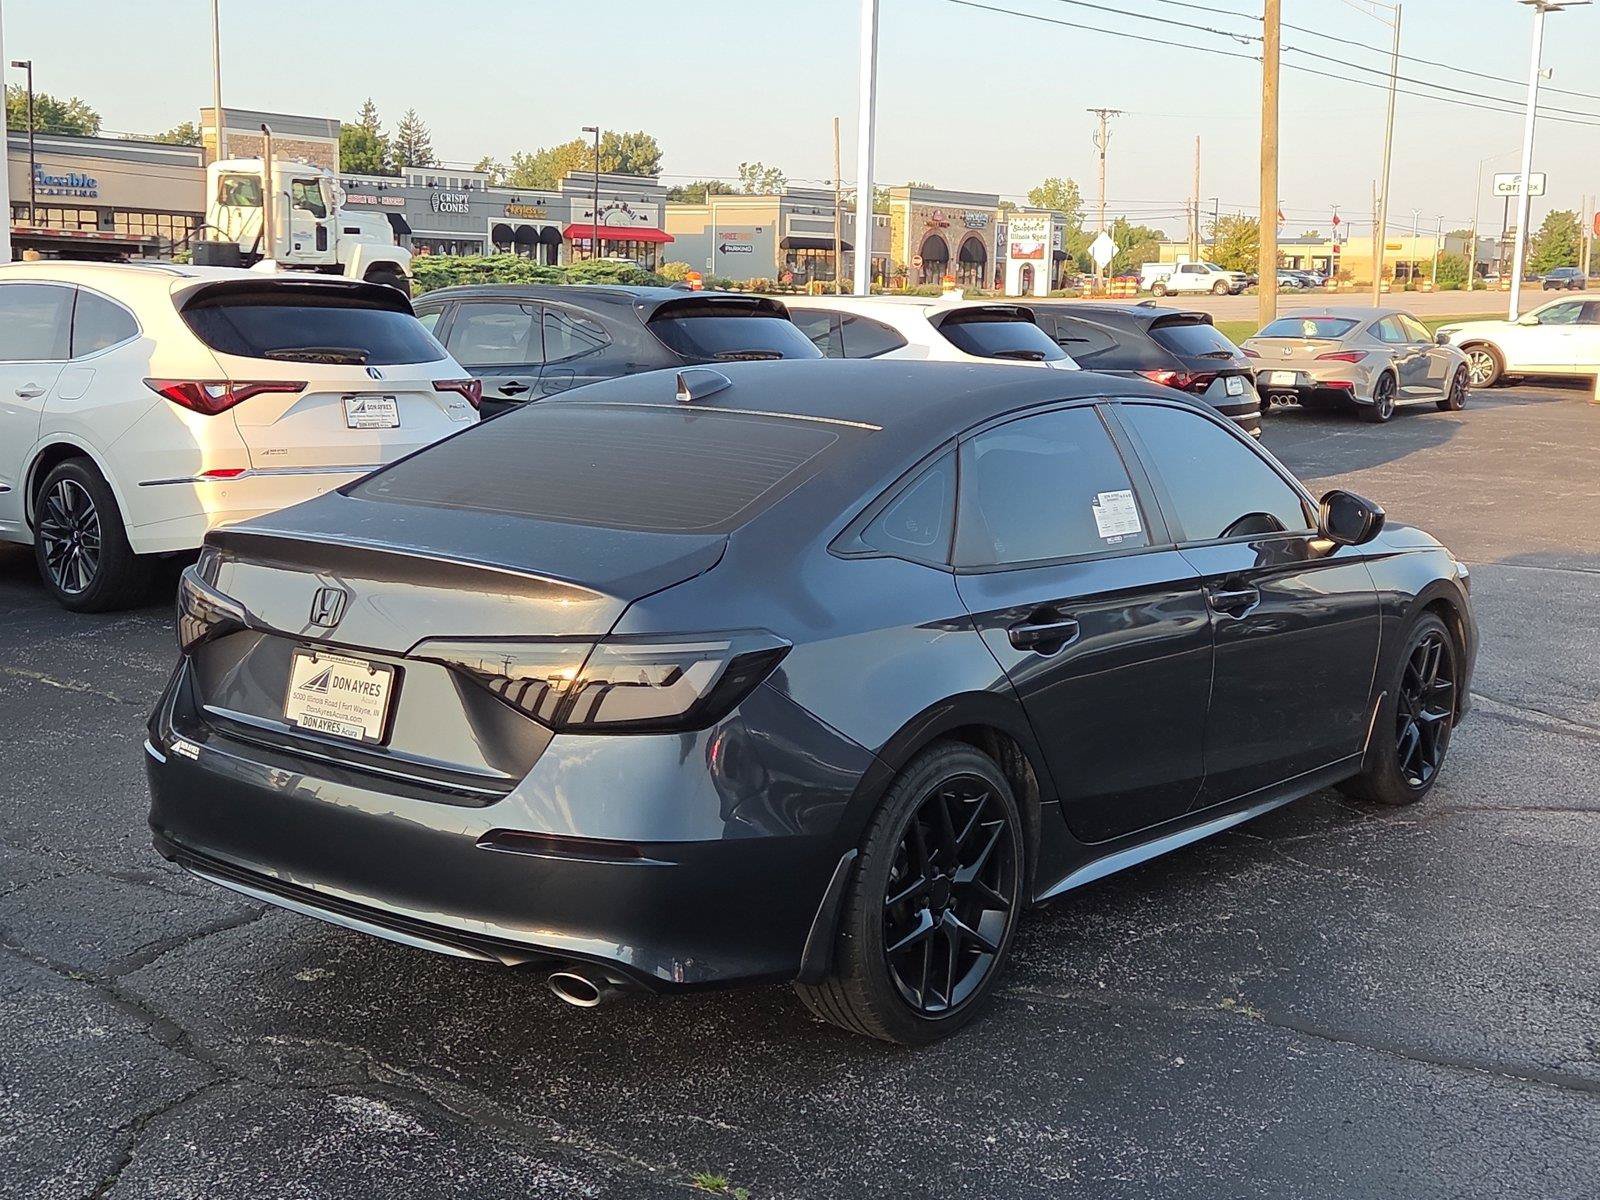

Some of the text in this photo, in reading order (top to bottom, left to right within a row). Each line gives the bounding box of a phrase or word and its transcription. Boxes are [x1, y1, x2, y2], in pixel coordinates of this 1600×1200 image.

[440, 192, 469, 203] CRISPY
[440, 203, 469, 213] CONES
[333, 675, 382, 697] DON AYRES
[307, 694, 324, 706] Illinois
[324, 698, 338, 708] Road
[342, 701, 353, 711] Fort
[306, 704, 363, 723] DonAyresAcura.com
[302, 715, 358, 738] DON AYRES Acura
